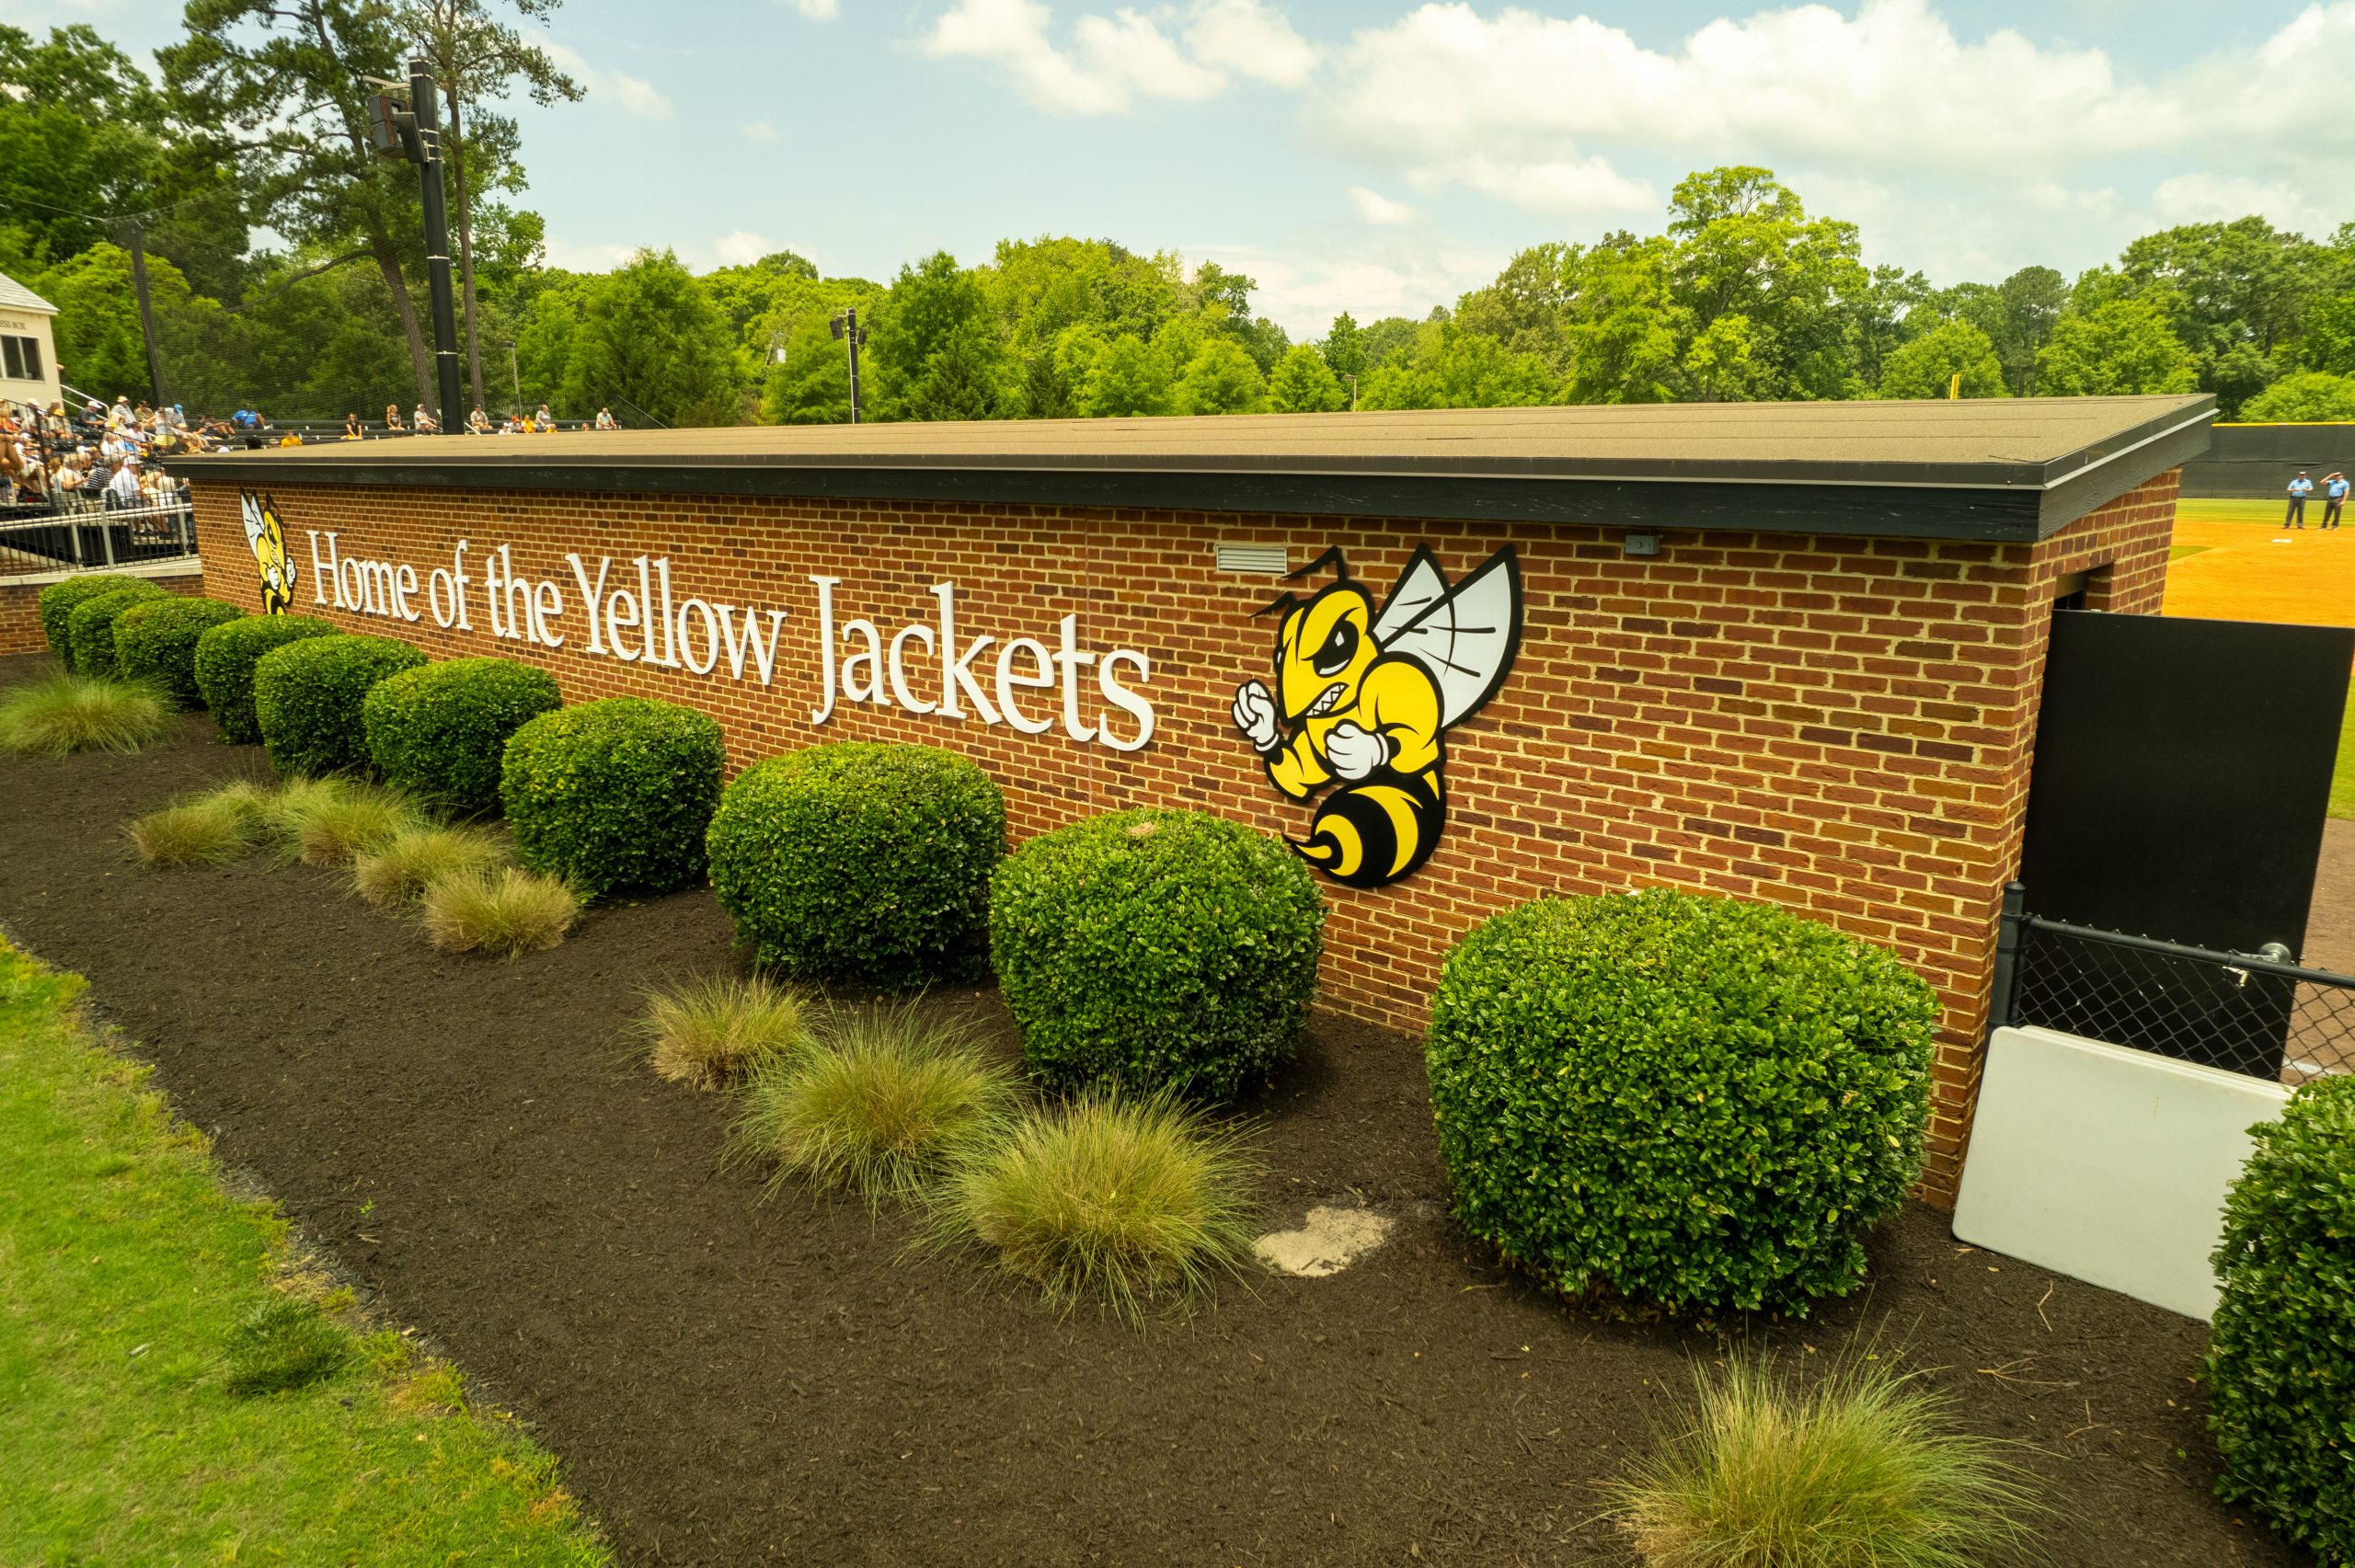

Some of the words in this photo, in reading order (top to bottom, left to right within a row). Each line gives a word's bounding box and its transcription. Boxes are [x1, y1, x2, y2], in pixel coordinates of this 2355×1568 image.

[11, 321, 27, 330] BOX
[305, 530, 420, 622] Home
[429, 539, 473, 631] of
[484, 543, 565, 647] the
[565, 553, 787, 686] Yellow
[809, 574, 1155, 751] Jackets
